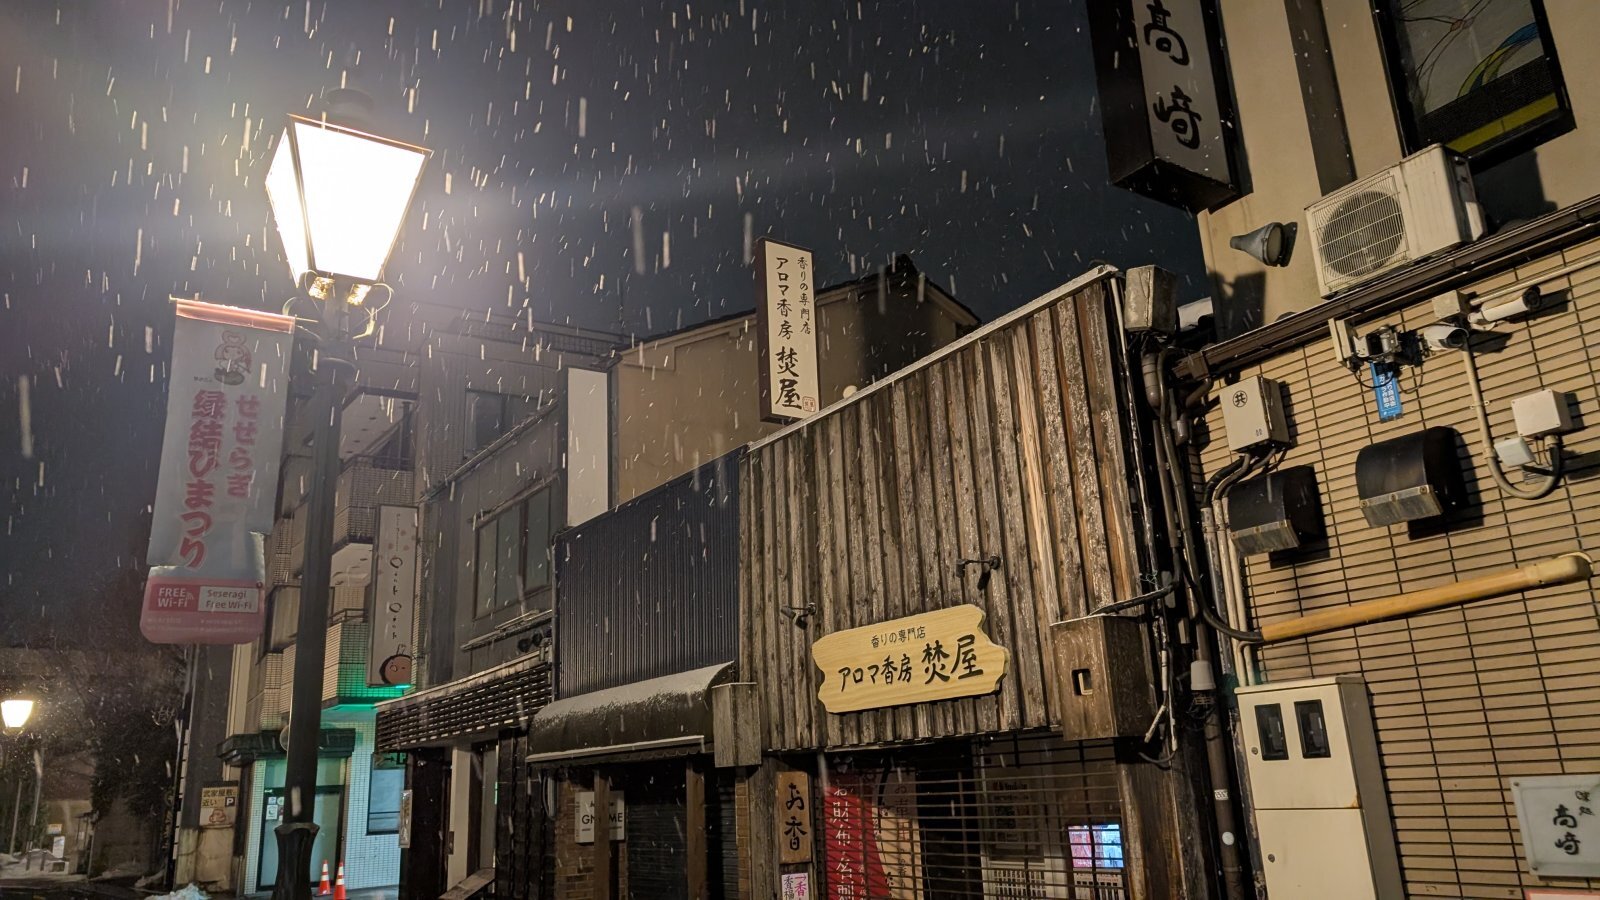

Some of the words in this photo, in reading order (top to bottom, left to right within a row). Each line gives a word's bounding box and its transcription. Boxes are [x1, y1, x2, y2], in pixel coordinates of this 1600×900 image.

[797, 257, 811, 335] 香りの専門店
[227, 394, 259, 498] せせらぎ
[158, 587, 187, 597] FREE
[207, 589, 247, 600] Seseragi
[157, 598, 188, 608] Wi-Fi
[205, 600, 227, 609] Free
[228, 601, 252, 610] Wi-Fi
[870, 626, 926, 648] 香りの専門店
[784, 782, 807, 850] お香
